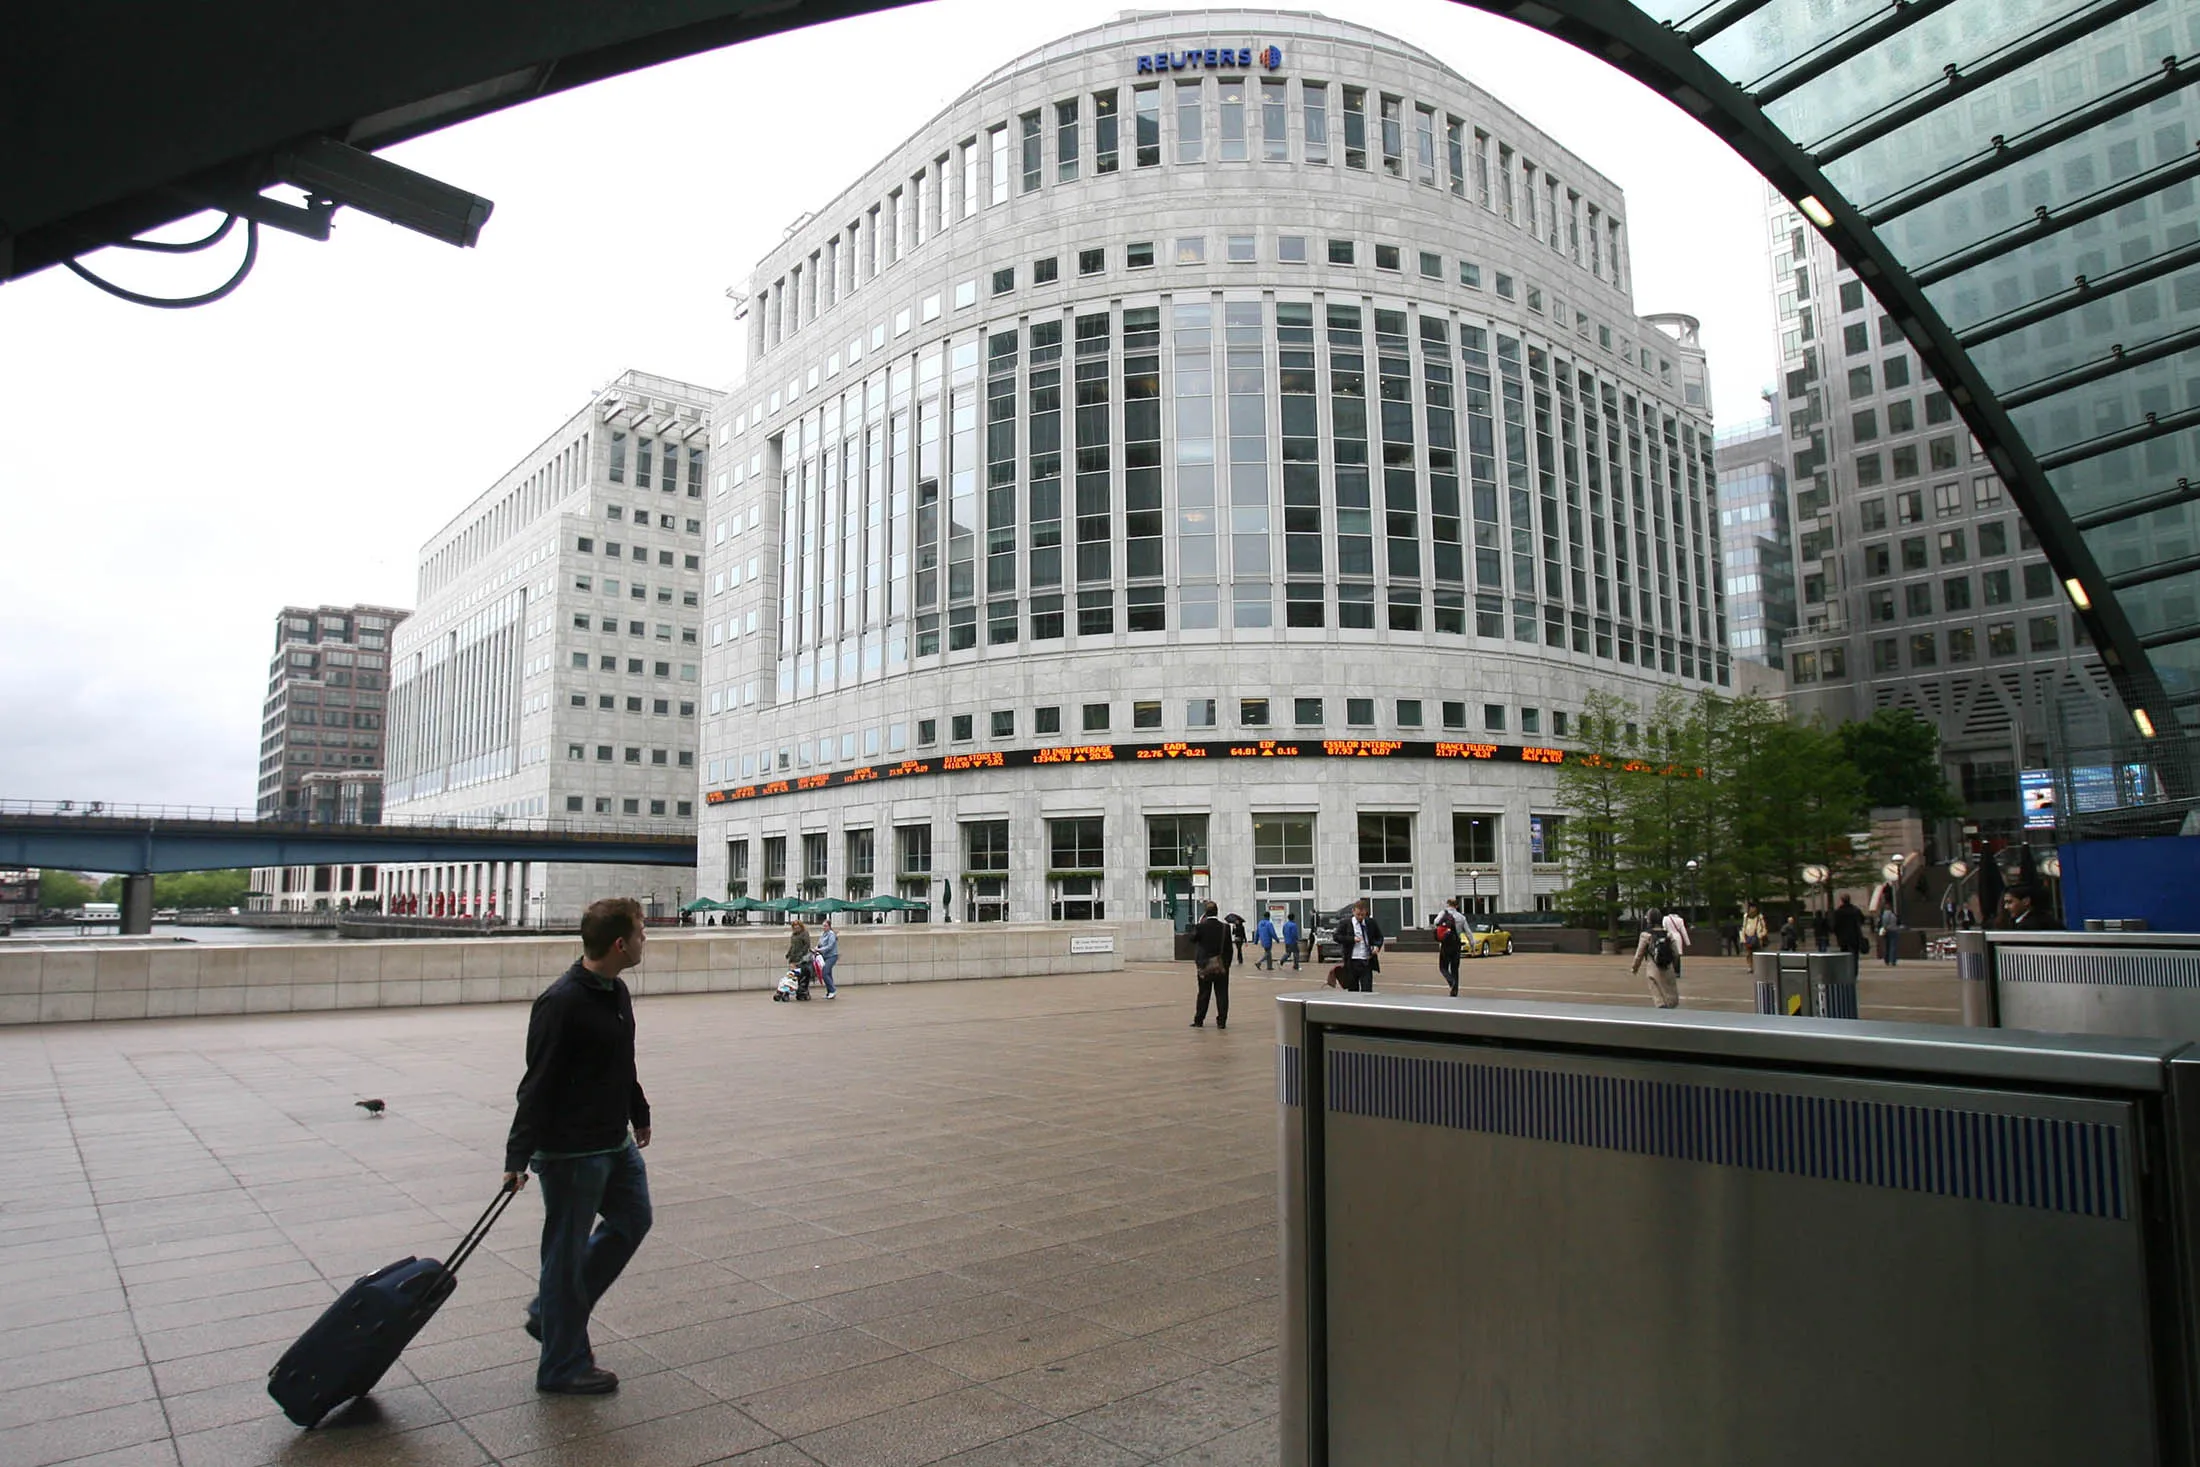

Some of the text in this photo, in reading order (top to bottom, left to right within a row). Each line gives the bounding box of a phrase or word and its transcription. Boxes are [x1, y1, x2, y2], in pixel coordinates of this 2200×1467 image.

[1137, 47, 1253, 74] REUTERS
[1361, 741, 1402, 749] INTERNAT
[1436, 742, 1496, 752] FRANCE TELECOM
[1074, 746, 1112, 754] AVERAGE
[1277, 747, 1298, 755] 0.16
